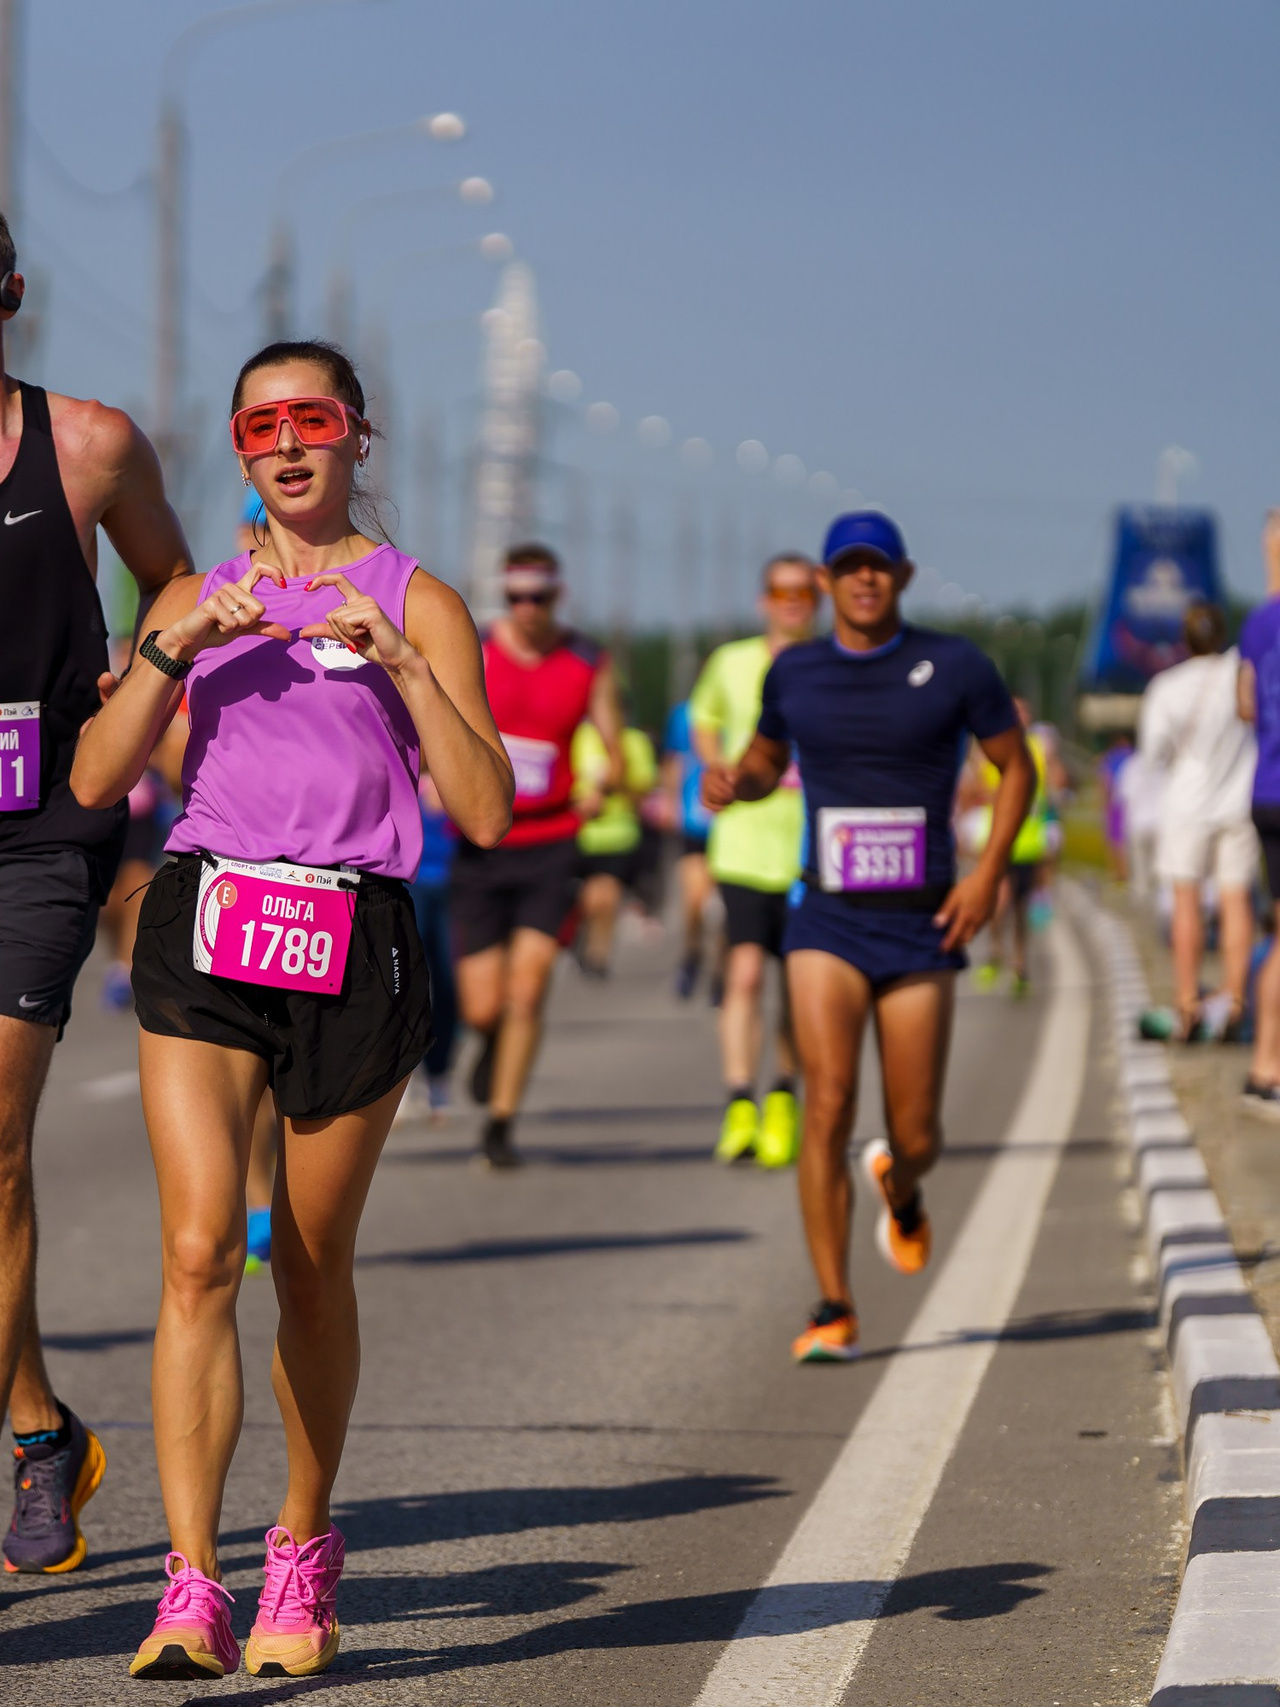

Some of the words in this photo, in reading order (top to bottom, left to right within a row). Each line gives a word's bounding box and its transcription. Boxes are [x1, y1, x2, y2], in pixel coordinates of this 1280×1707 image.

[851, 844, 916, 882] 3331
[316, 875, 332, 885] Пэй
[262, 894, 315, 922] ОЛЬГА
[240, 919, 333, 978] 1789
